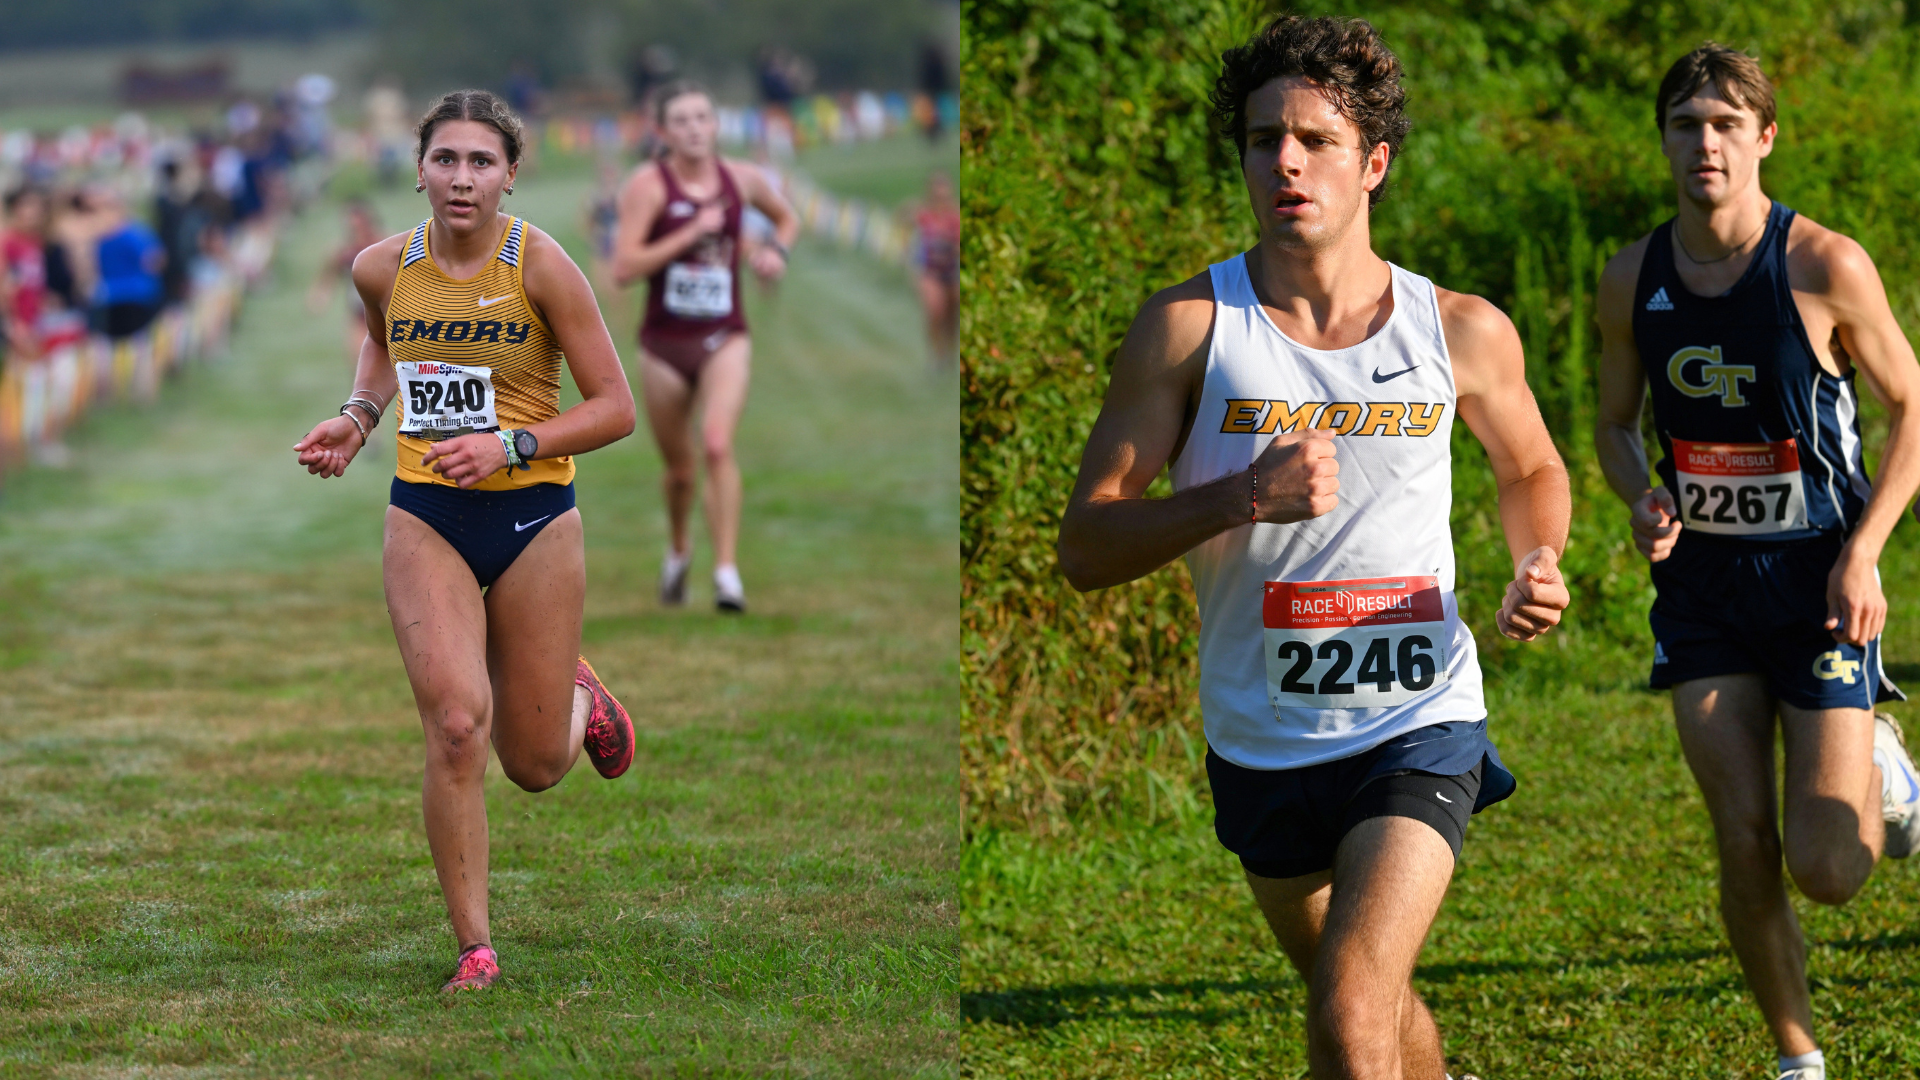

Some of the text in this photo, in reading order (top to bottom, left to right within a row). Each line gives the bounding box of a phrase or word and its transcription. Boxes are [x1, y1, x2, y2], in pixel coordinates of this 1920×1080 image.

[391, 319, 530, 344] EMORY
[1667, 345, 1756, 407] GT
[408, 378, 485, 415] 5240
[409, 415, 487, 428] Perfect Timing Group
[1219, 398, 1445, 438] EMORY
[1688, 453, 1775, 467] RACE RESULT
[1685, 482, 1792, 525] 2267
[1291, 594, 1413, 615] RACE RESULT
[1353, 613, 1376, 621] German
[1277, 634, 1436, 695] 2246
[1812, 650, 1860, 684] GT
